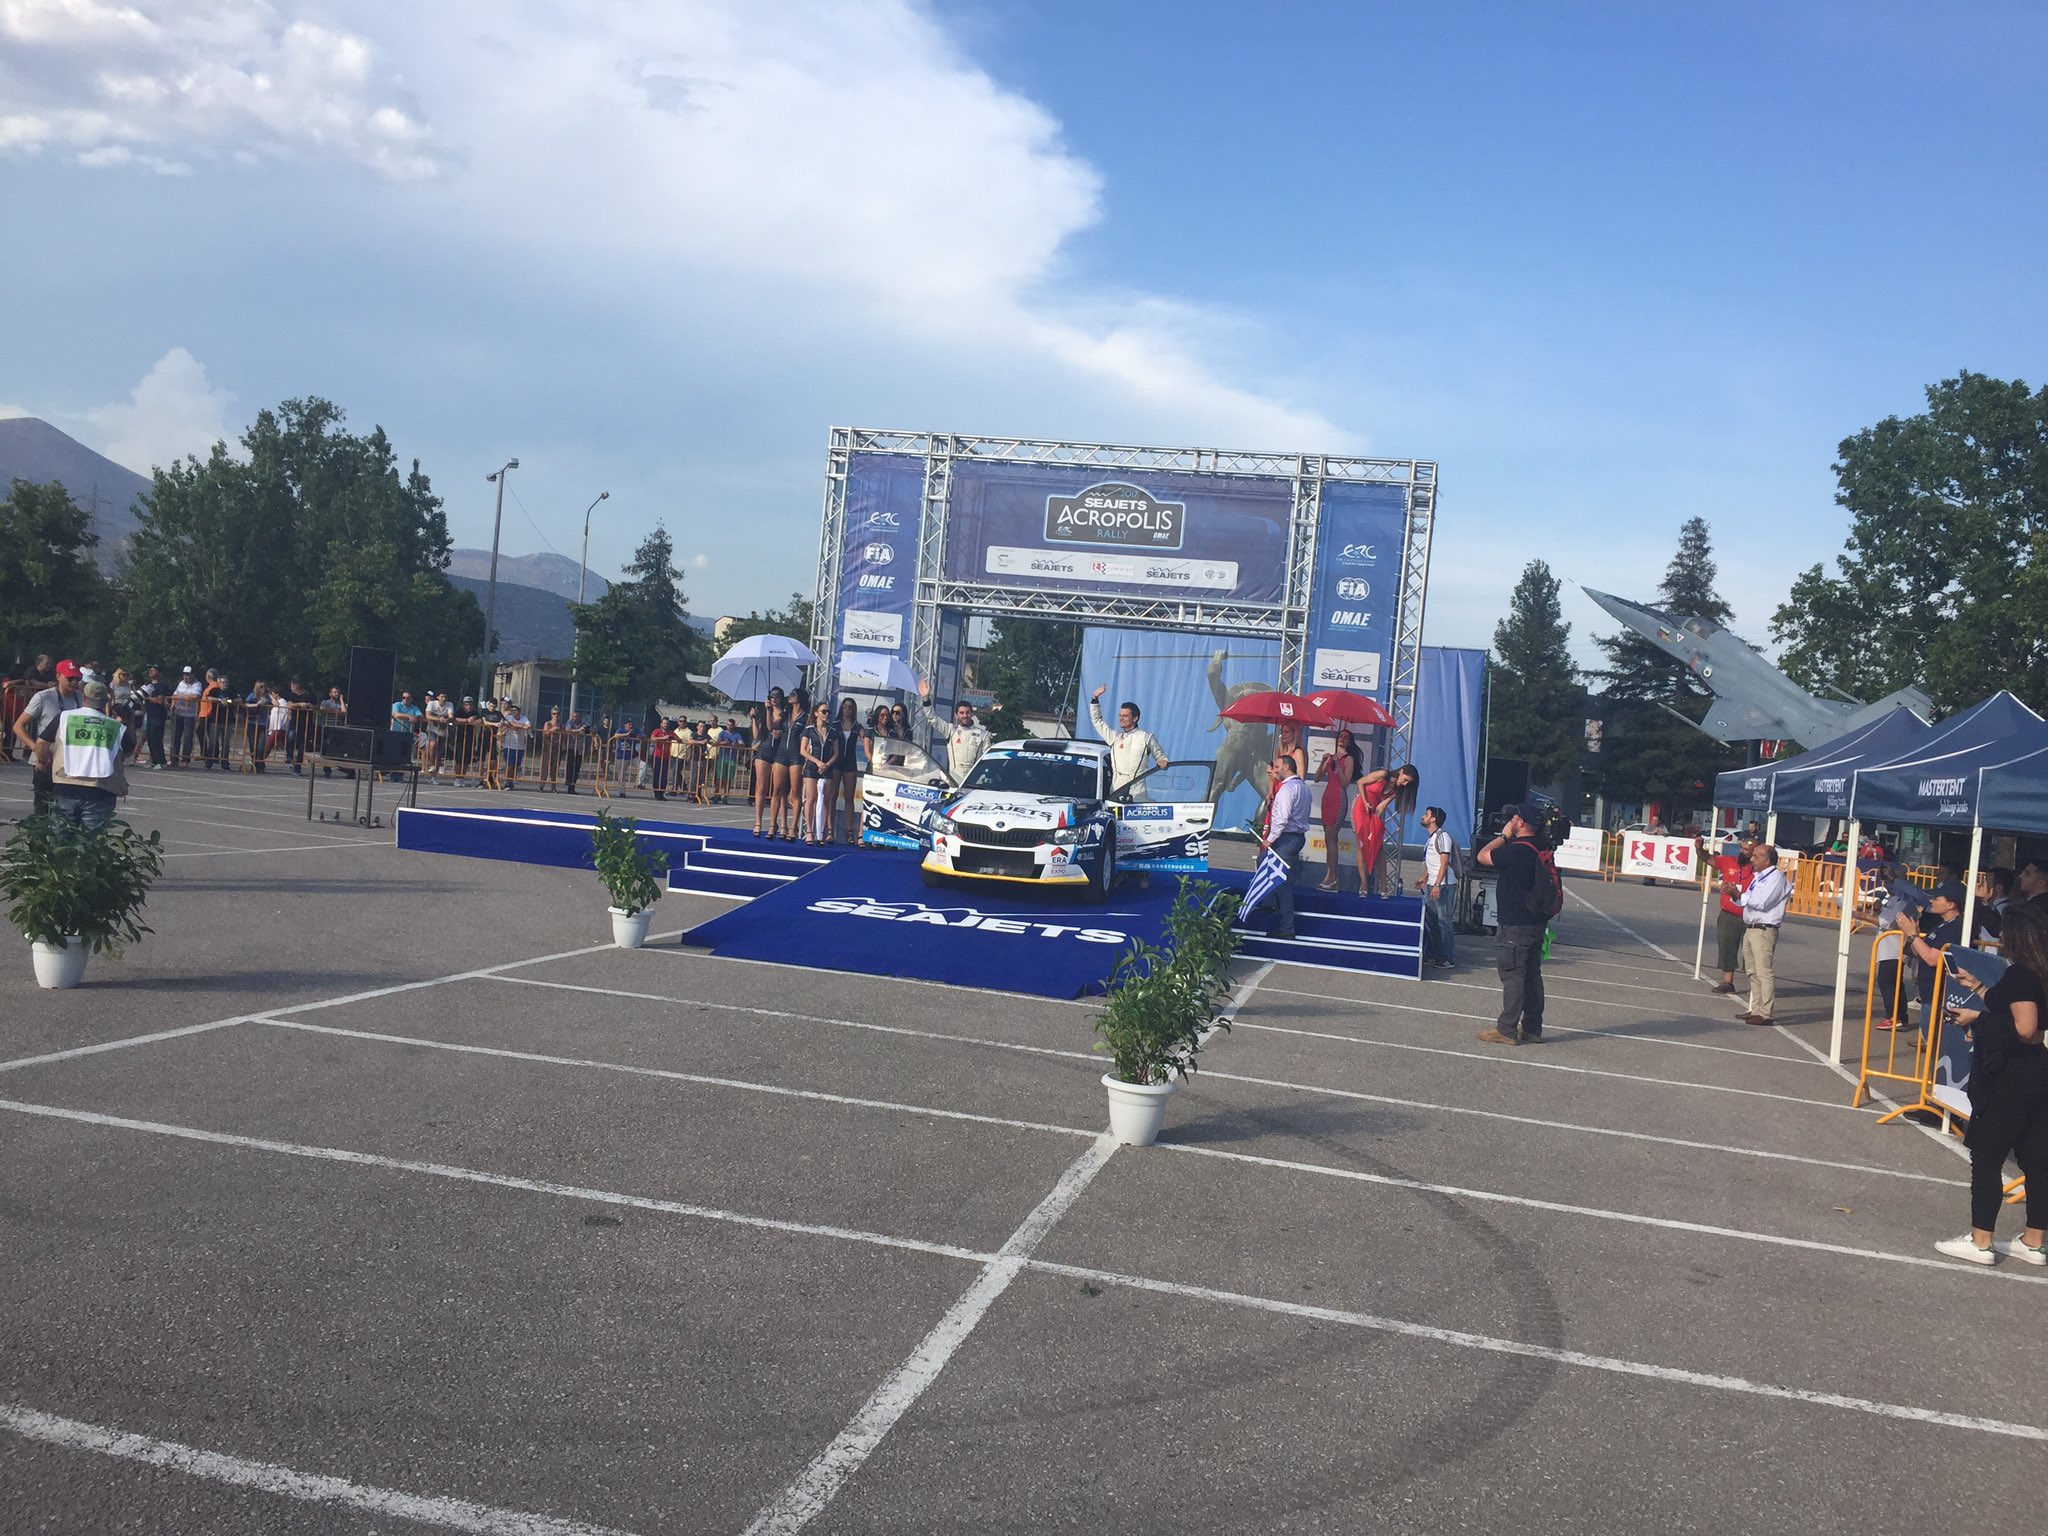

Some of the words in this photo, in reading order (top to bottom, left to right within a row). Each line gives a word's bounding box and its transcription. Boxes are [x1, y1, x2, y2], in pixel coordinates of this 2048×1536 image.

[1120, 490, 1139, 498] 2017
[1084, 497, 1148, 511] SEAJETS
[1057, 505, 1173, 530] ACROPOLIS
[1097, 529, 1129, 539] RALLY
[1030, 562, 1074, 573] SEAJETS
[859, 574, 895, 589] OMAE
[1146, 570, 1190, 580] SEAJETS
[1331, 610, 1372, 627] OMAE
[850, 632, 895, 643] SEAJETS
[1321, 672, 1371, 683] SEAJETS
[1017, 751, 1073, 762] SEAJETS
[898, 785, 935, 800] ACROPOLIS
[1814, 778, 1847, 793] MASTERTENT
[1917, 776, 1968, 797] MASTERTENT
[962, 805, 1054, 822] SEAJETS
[1112, 806, 1119, 820] 1
[1184, 840, 1210, 857] SE
[1051, 856, 1067, 864] ERA
[806, 900, 1127, 943] SEAJETS
